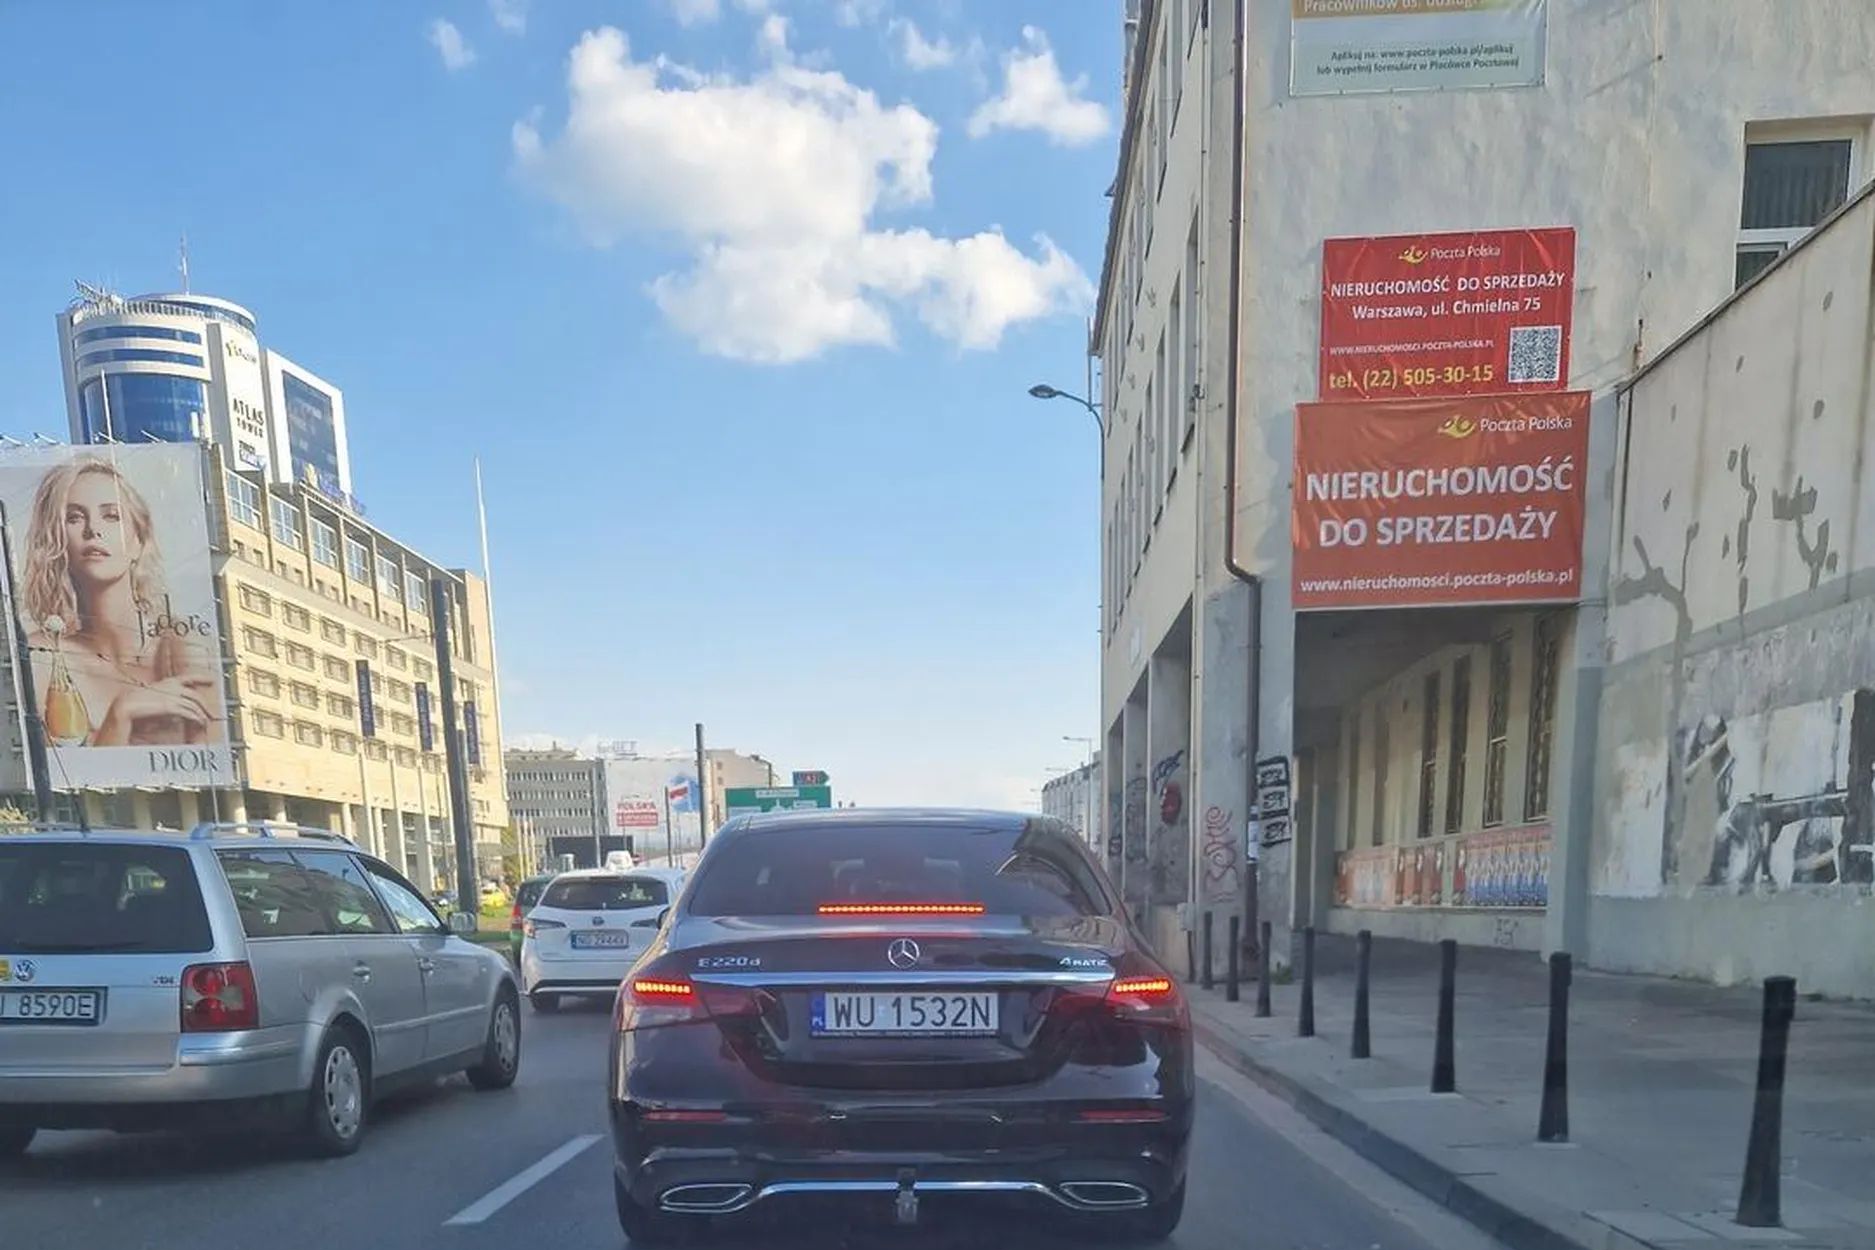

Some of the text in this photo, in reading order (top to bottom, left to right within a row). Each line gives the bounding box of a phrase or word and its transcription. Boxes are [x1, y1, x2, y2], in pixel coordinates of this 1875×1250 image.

[1317, 65, 1332, 75] lub
[1374, 61, 1417, 74] formularz
[1419, 62, 1429, 71] w
[1430, 244, 1501, 260] Poczta Polska
[1331, 270, 1566, 298] NIERUCHOMOŚĆ DO SPRZEDAŻY
[1352, 297, 1541, 320] Warszawa, ul. Chmielna 75
[1329, 364, 1493, 390] tel. (22) 505-30-15
[233, 397, 265, 427] ATLAS
[1480, 415, 1573, 433] Poczta Polska
[1306, 455, 1574, 501] NIERUCHOMOŚĆ
[1319, 504, 1557, 548] DO SPRZEDAŻY
[1301, 568, 1573, 593] www.nieruchomosci.poczta-polska.pl
[150, 751, 220, 773] DIOR
[18, 994, 93, 1018] 8590E
[833, 995, 990, 1028] WU 1532N
